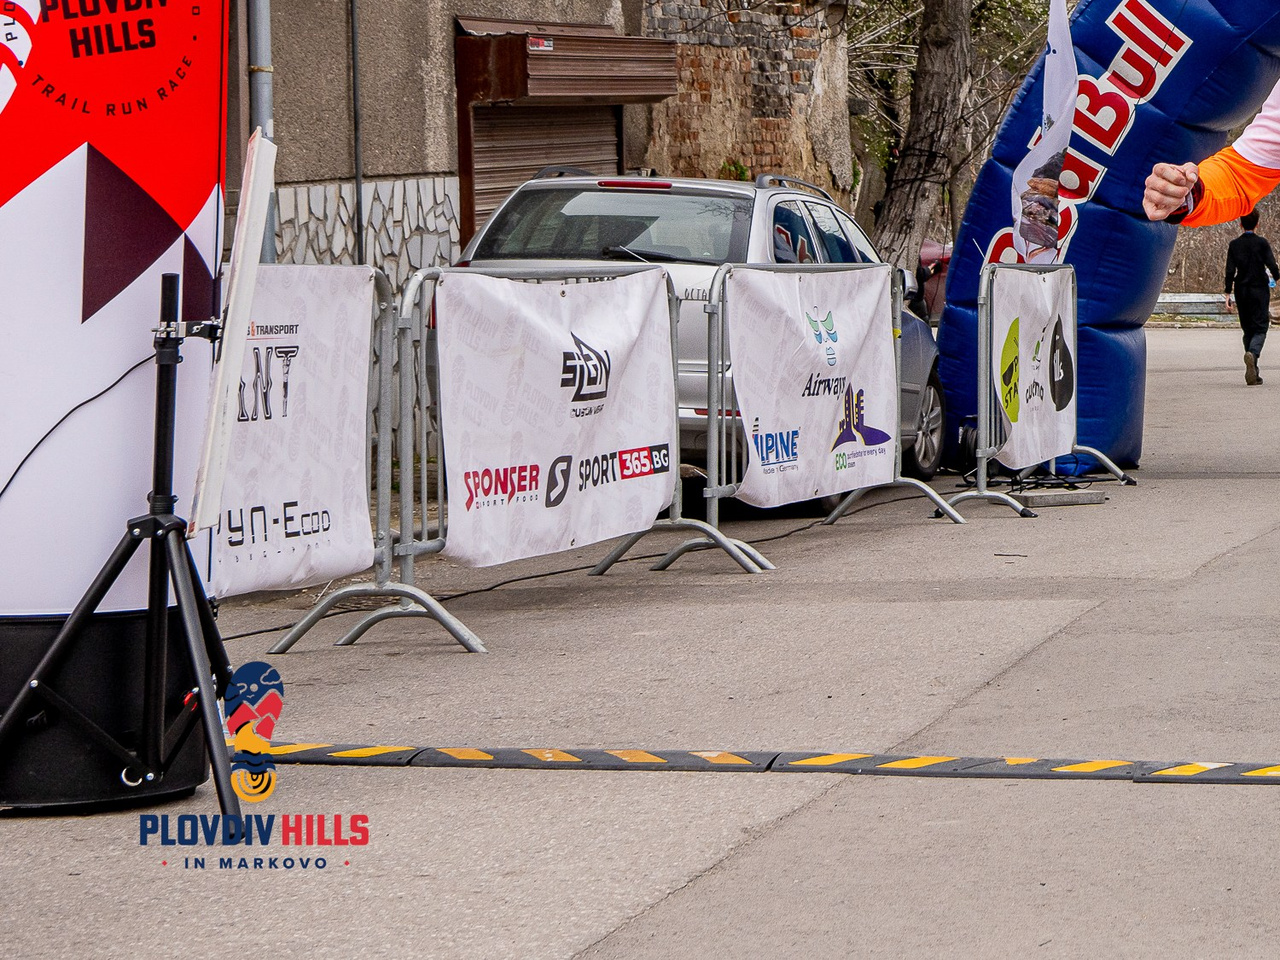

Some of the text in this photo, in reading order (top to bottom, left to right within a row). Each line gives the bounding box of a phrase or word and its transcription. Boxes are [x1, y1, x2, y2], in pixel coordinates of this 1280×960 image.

[69, 18, 156, 58] HILLS
[31, 55, 192, 116] TRAIL RUN RACE
[464, 464, 540, 512] SPONSER
[578, 452, 618, 492] SPORT
